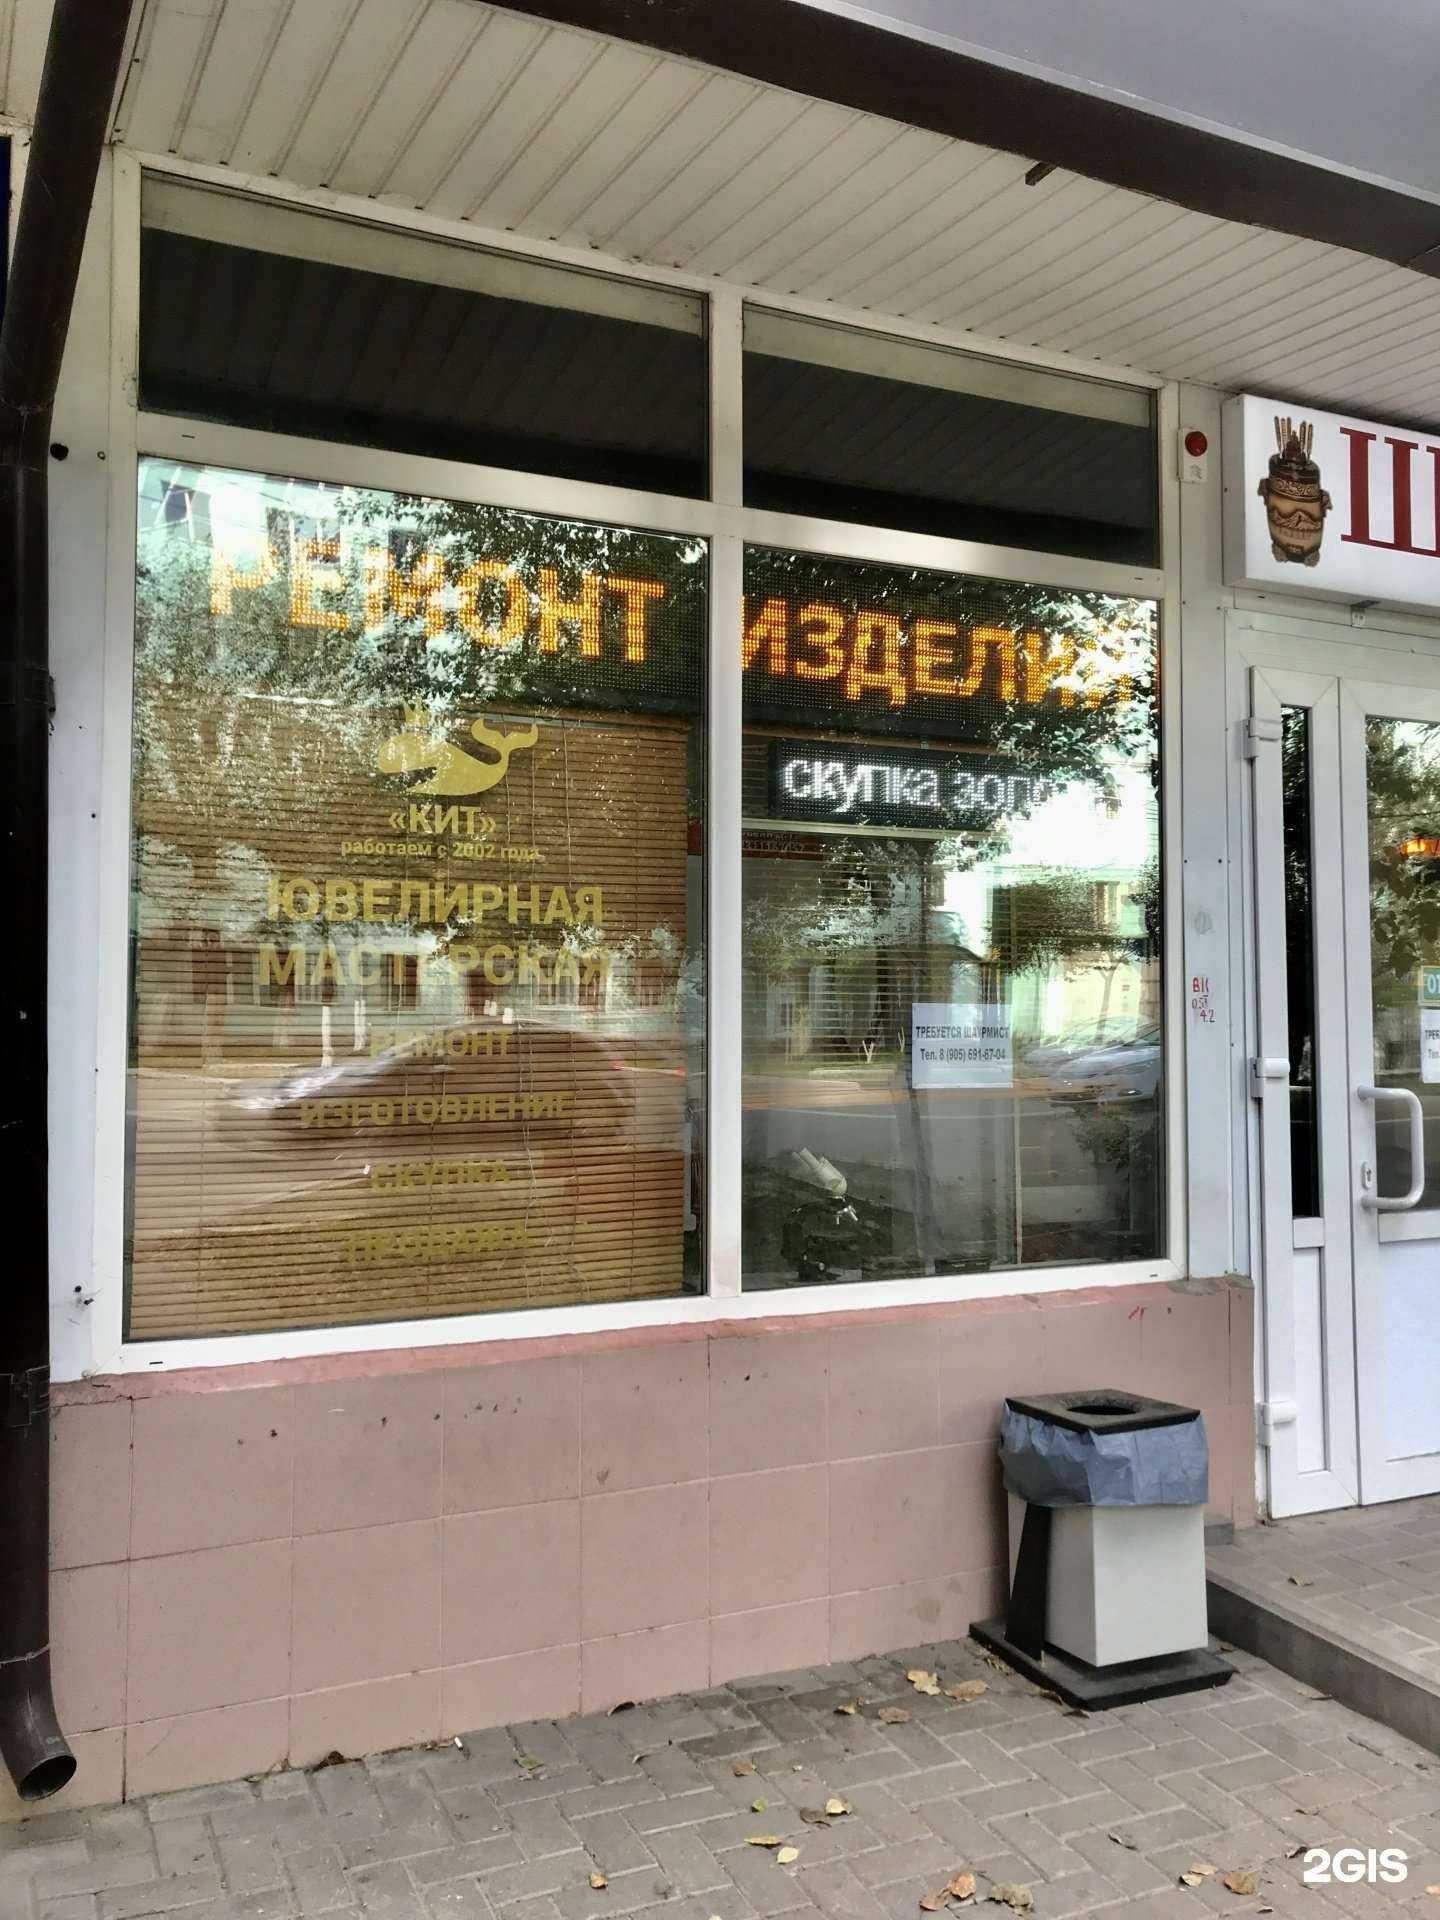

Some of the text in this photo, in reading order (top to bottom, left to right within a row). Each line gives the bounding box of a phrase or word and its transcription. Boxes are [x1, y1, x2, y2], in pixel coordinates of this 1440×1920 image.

[211, 537, 666, 662] РЕМОНТ
[783, 759, 940, 813] скупка
[388, 804, 496, 835] «КИТ»
[341, 838, 540, 862] работаем с 2002 года
[267, 878, 603, 925] ЮВЕЛИРНАЯ
[258, 942, 611, 987] МАСТЕРСКАЯ
[915, 1026, 962, 1039] ТРЕБУЕТСЯ
[920, 1048, 938, 1061] Тел.
[939, 1048, 945, 1060] 8
[946, 1048, 966, 1064] (905)
